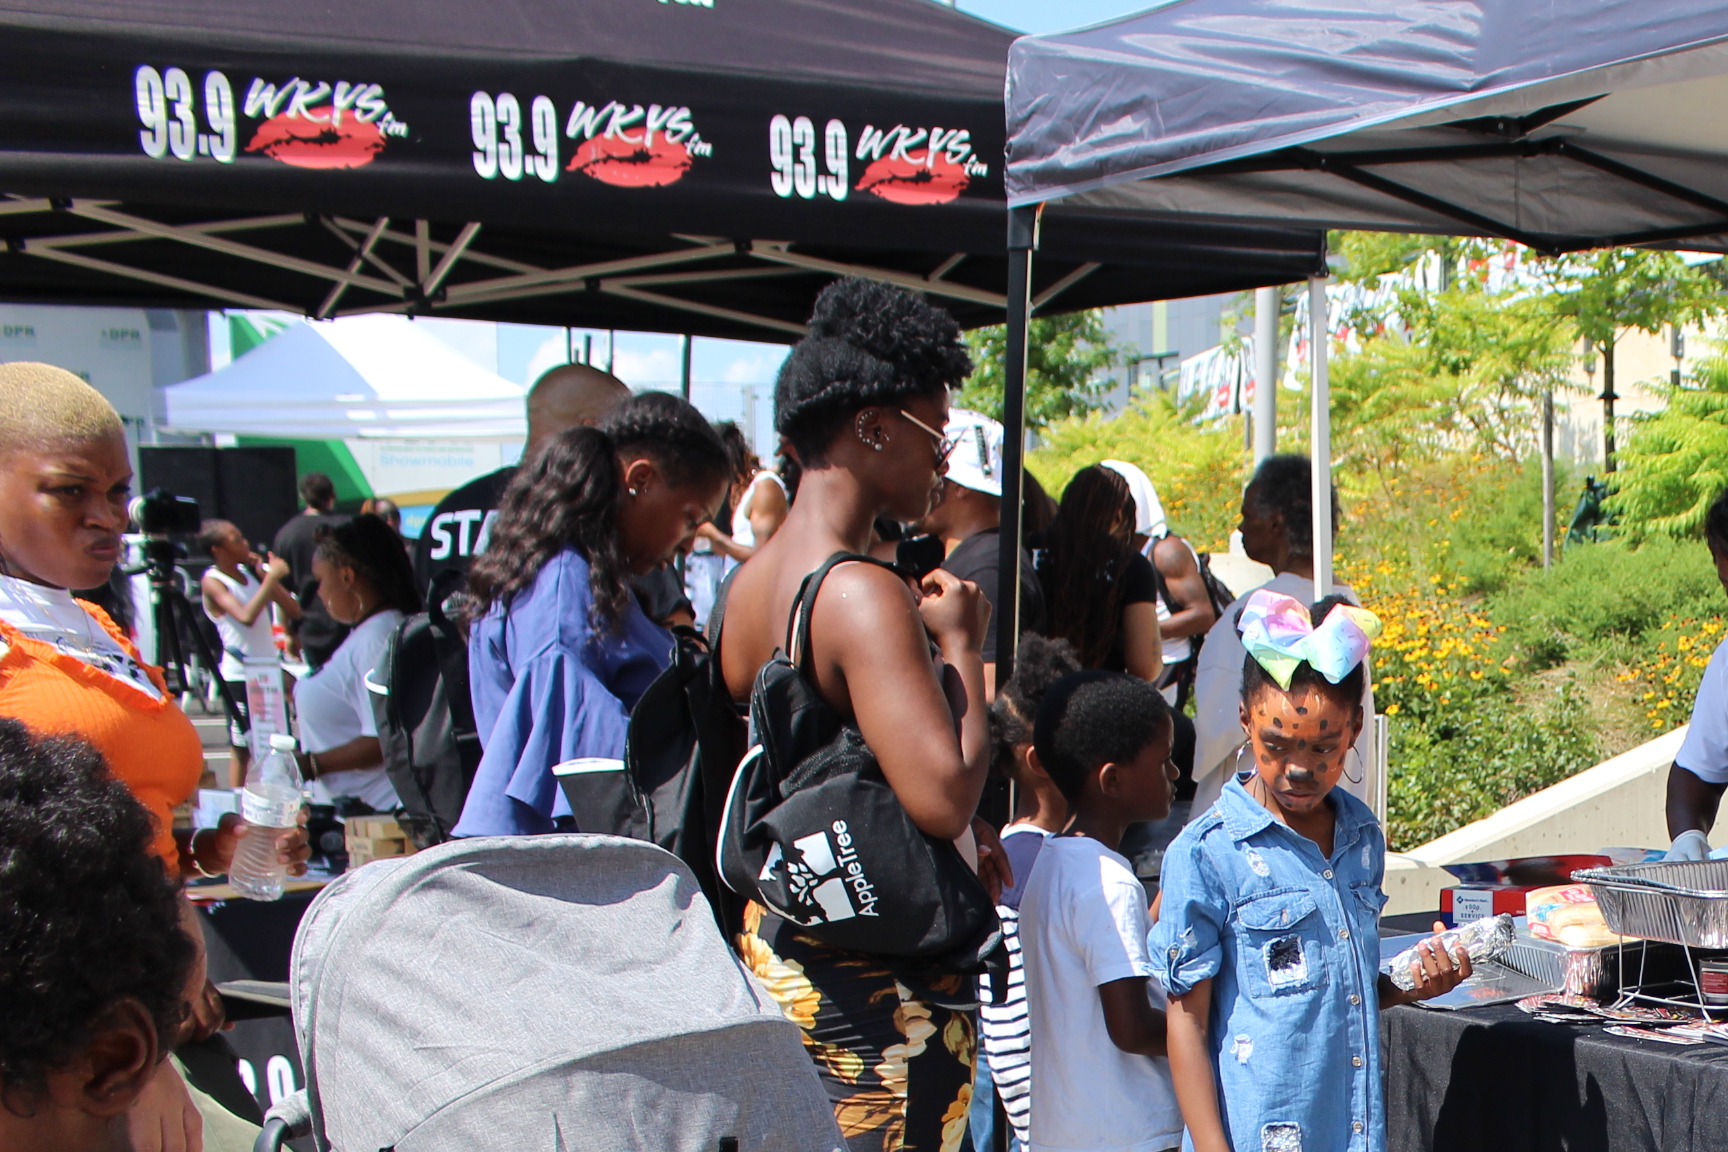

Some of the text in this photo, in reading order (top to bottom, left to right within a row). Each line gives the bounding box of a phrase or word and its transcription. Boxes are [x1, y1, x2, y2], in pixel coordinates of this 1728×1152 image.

[135, 64, 236, 164] 93.9
[244, 77, 388, 128] WKYS
[470, 90, 559, 183] 93.9
[566, 100, 695, 148] WKYS
[769, 113, 849, 201] 93.9
[855, 123, 972, 169] WKYS
[831, 818, 880, 917] AppleTree
